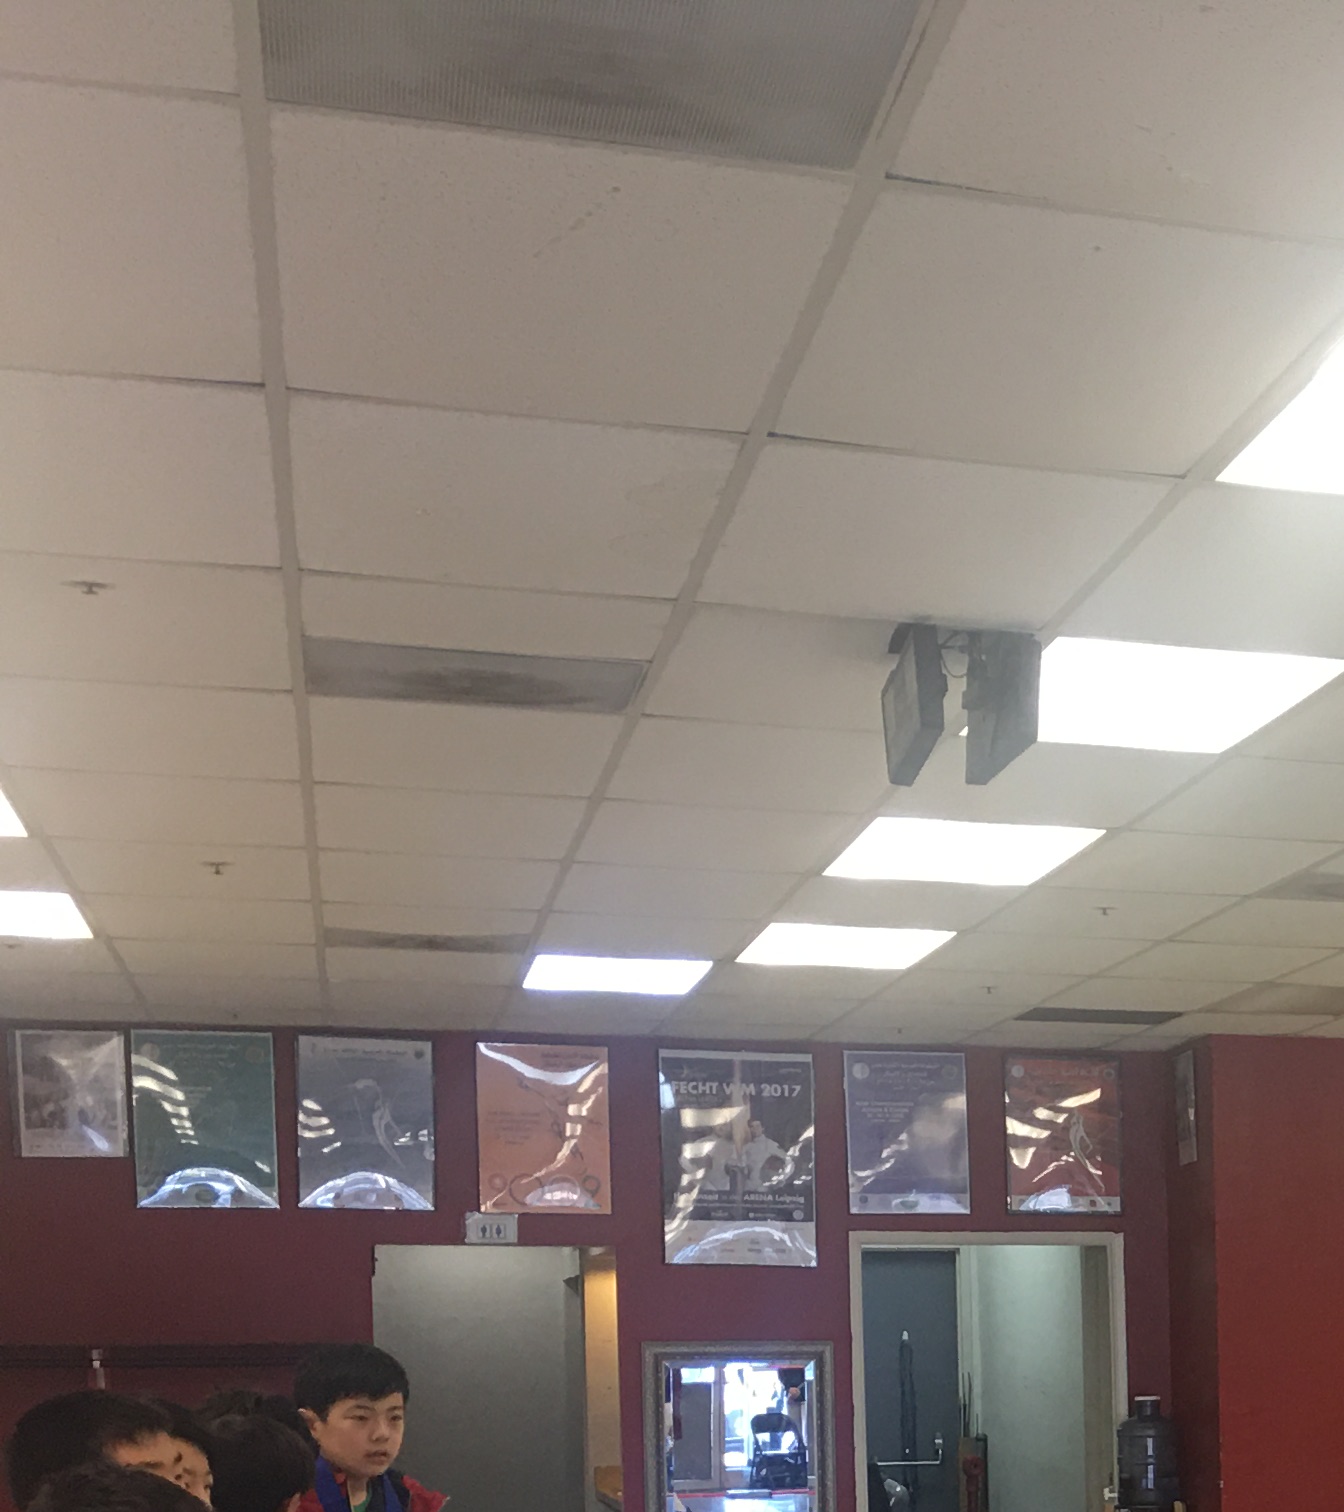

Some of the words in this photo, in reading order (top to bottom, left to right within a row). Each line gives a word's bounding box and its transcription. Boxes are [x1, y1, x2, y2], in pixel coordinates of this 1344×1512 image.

[671, 1081, 719, 1095] FECHT
[722, 1083, 756, 1096] WM
[760, 1083, 802, 1097] 2017
